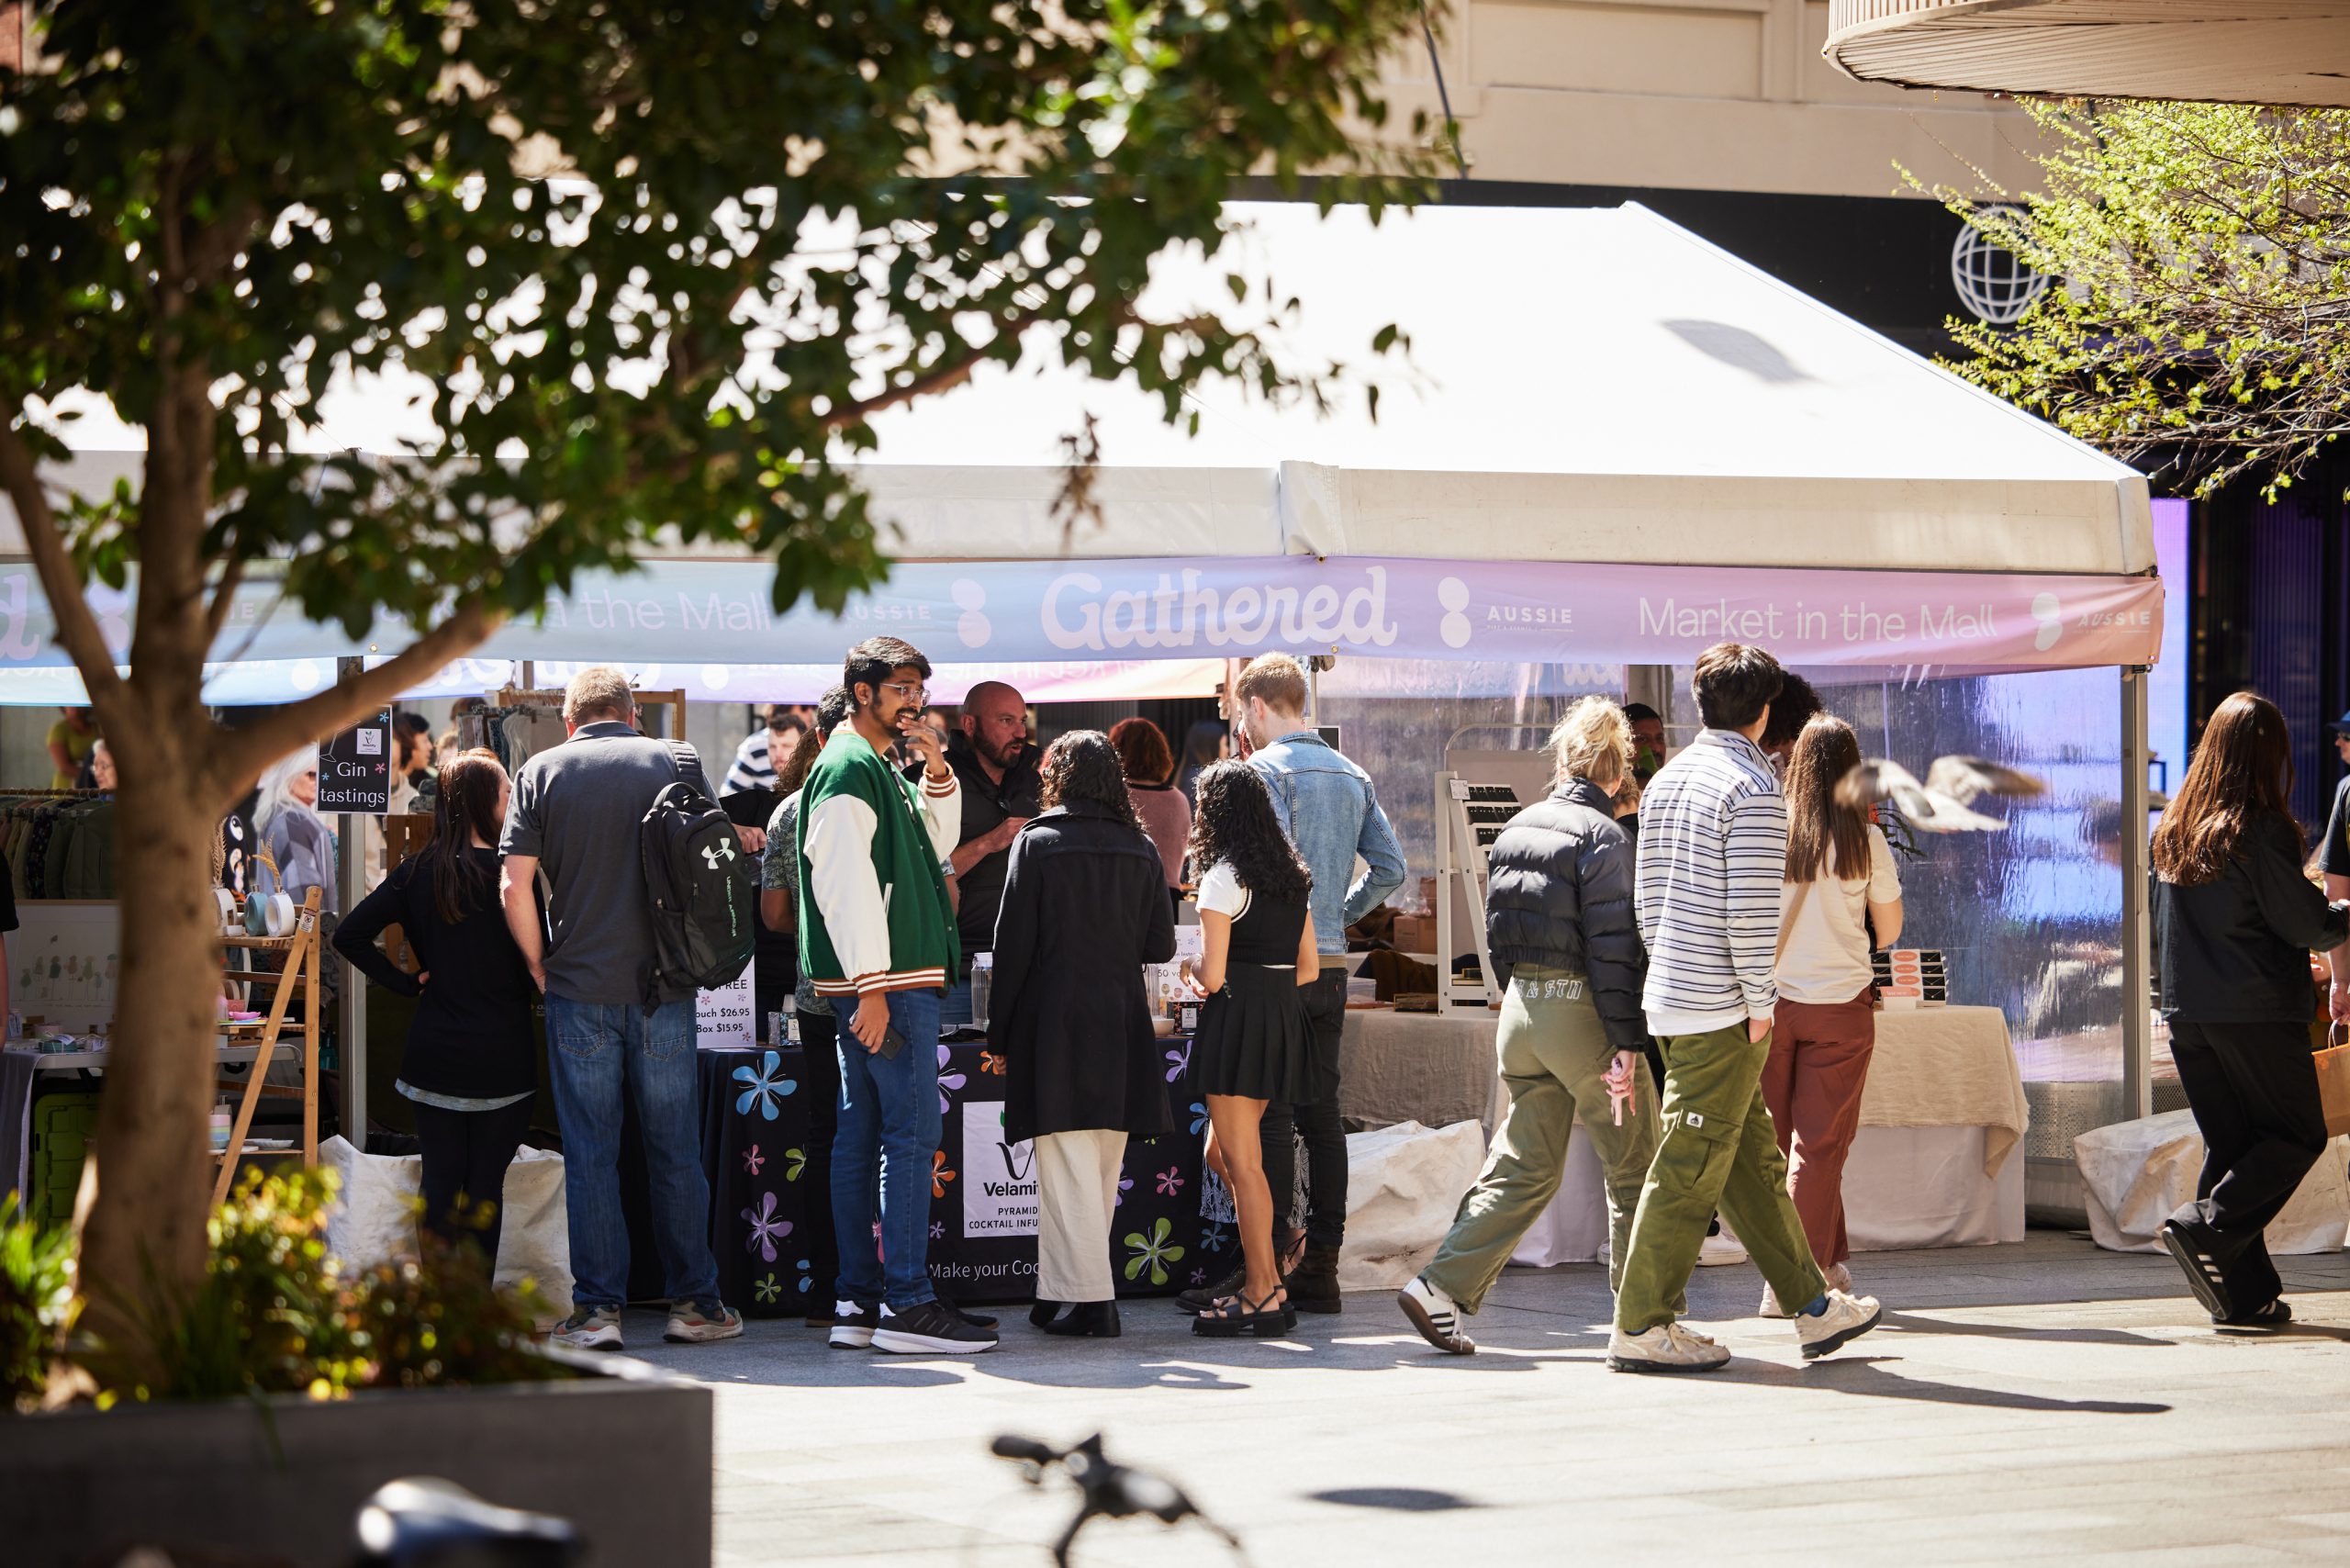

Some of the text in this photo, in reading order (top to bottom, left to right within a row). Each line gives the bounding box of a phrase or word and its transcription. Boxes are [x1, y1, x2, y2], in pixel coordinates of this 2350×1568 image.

[580, 589, 666, 630] the
[677, 591, 771, 631] Mall
[1041, 566, 1398, 650] Gathered
[1487, 606, 1572, 624] AUSSIE
[1639, 598, 1998, 642] Market in the Mall
[2078, 610, 2152, 627] AUSSIE
[337, 762, 366, 778] Gin
[319, 788, 386, 808] tastings
[696, 1008, 750, 1018] ouch $26.95
[697, 1023, 744, 1033] Box $15.95
[983, 1181, 1038, 1197] Velami
[998, 1206, 1038, 1216] PYRAMID
[968, 1220, 1013, 1229] COCKTAIL
[929, 1262, 970, 1279] Make
[974, 1263, 1009, 1282] your
